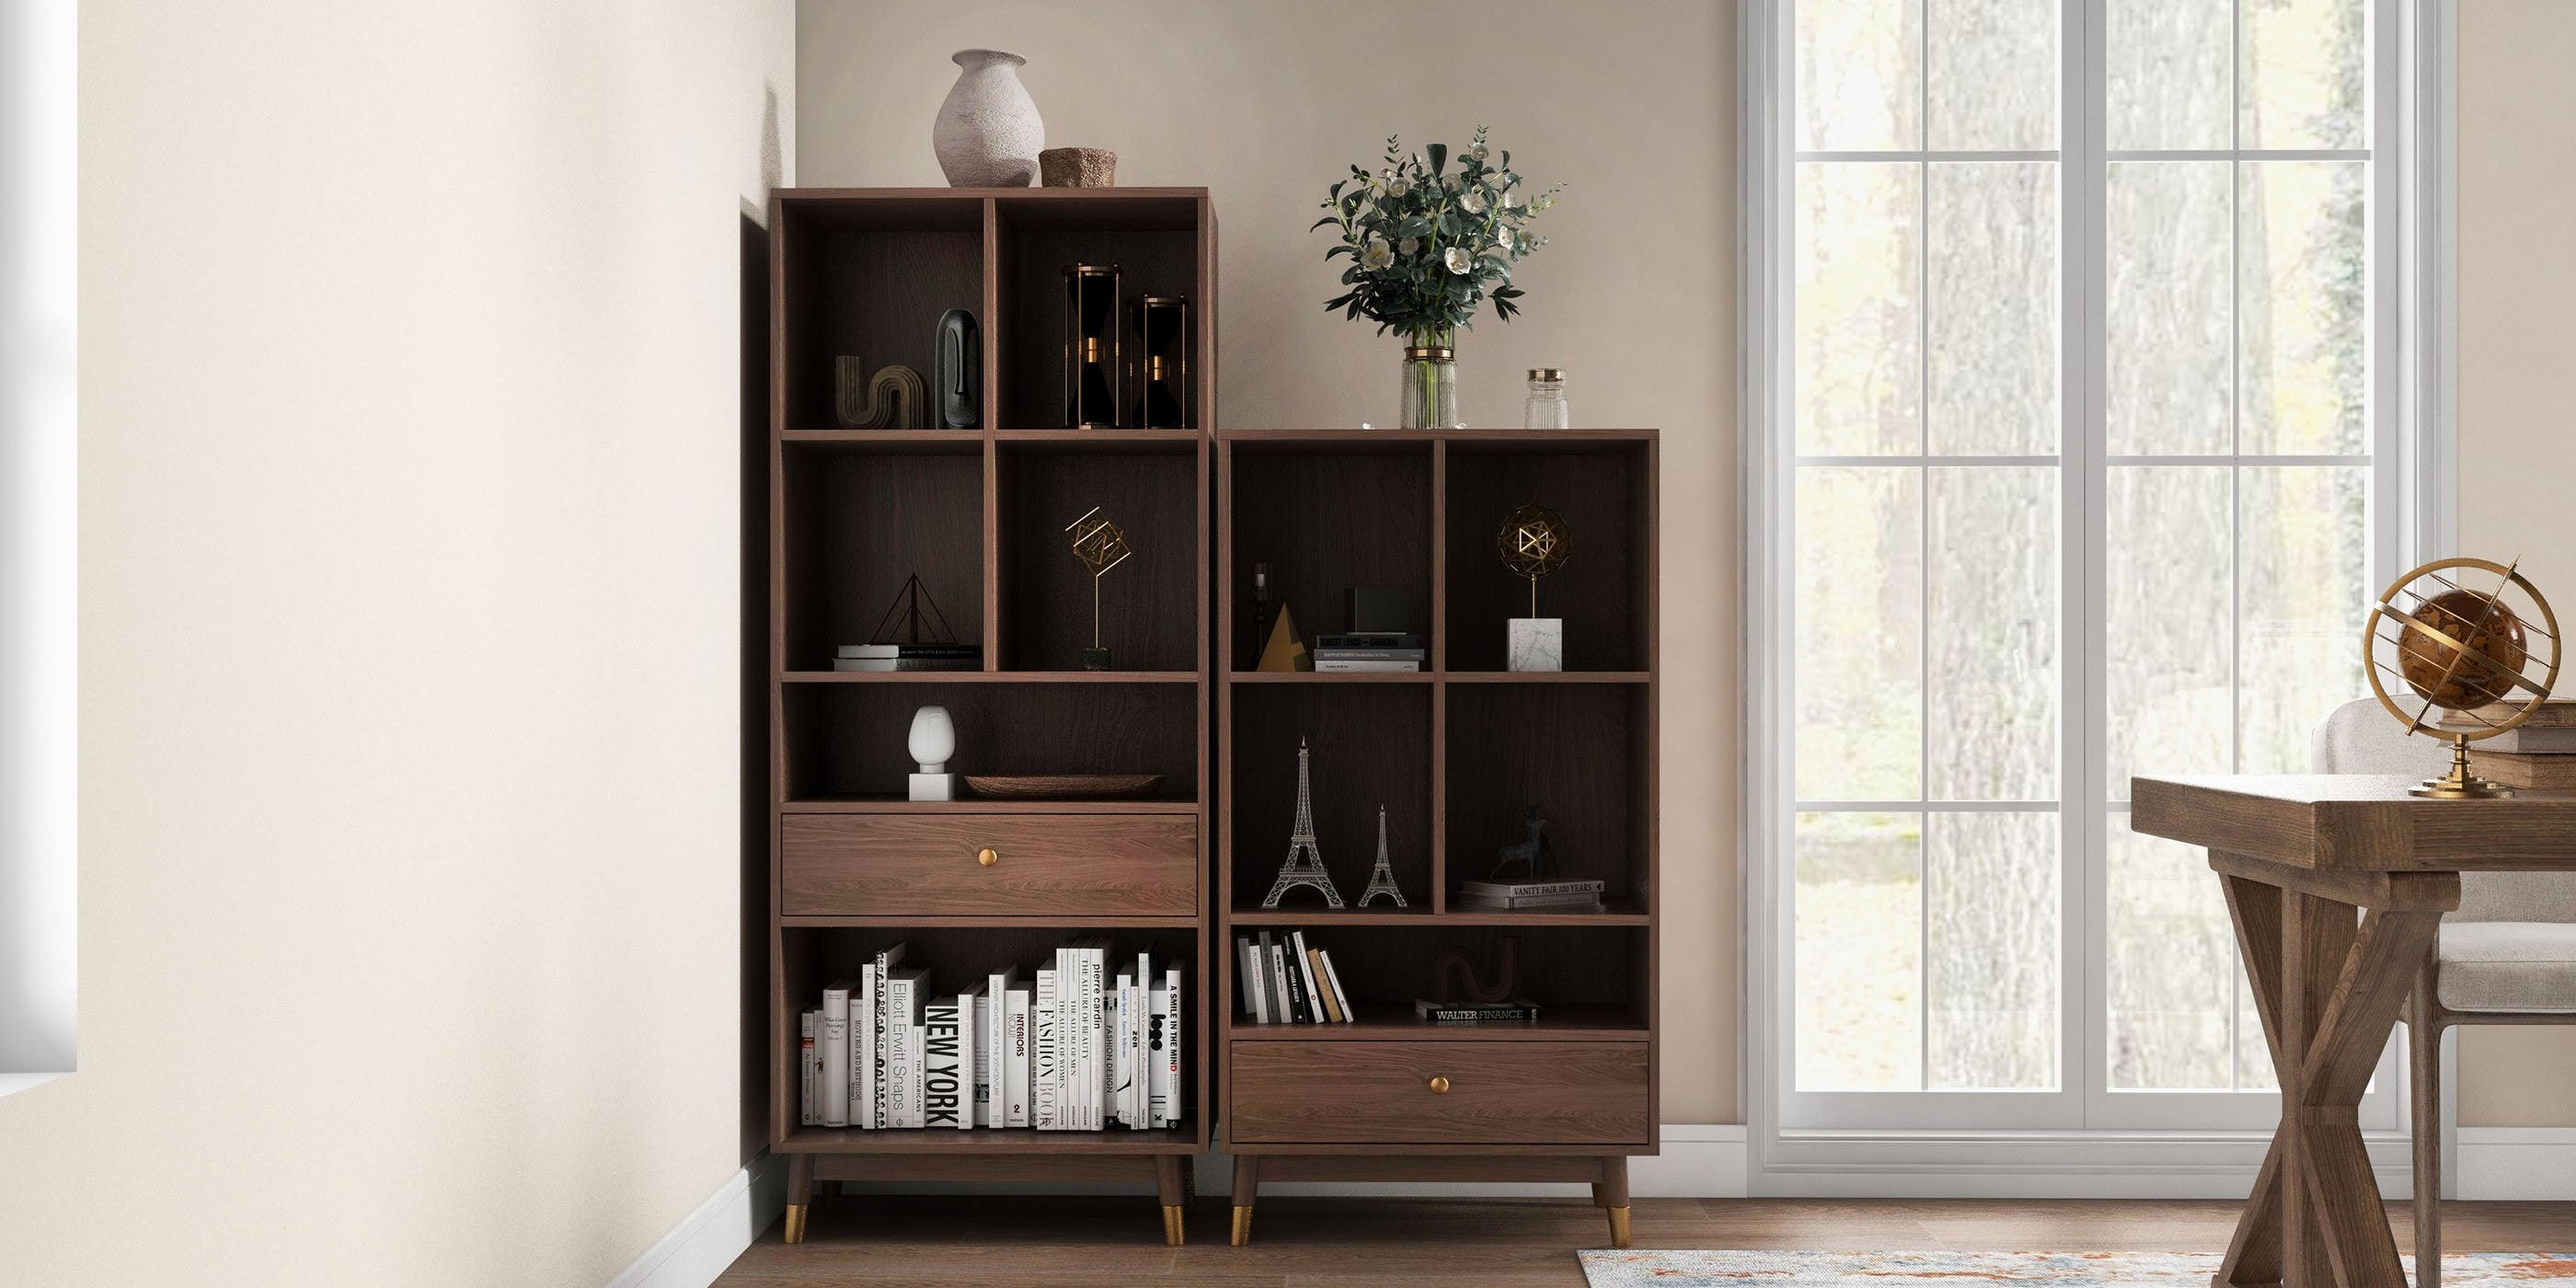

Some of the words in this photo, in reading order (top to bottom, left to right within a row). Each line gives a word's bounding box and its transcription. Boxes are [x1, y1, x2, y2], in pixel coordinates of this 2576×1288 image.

[1513, 887, 1540, 895] VANITY
[1542, 886, 1558, 894] FAIR
[1570, 883, 1592, 891] YEARS
[1040, 972, 1054, 1005] THE
[1092, 964, 1100, 994] pierre
[893, 983, 906, 1018] Elliott
[1436, 1011, 1478, 1019] WALTER
[1478, 1010, 1523, 1018] FINANCE
[926, 1008, 959, 1057] NEW
[1082, 1012, 1088, 1024] OF
[1149, 1014, 1167, 1051] logo
[1170, 1021, 1178, 1029] IN
[893, 1024, 906, 1061] Erwitt
[1040, 1010, 1054, 1077] FASHION
[1060, 1047, 1065, 1058] OF
[1071, 1047, 1076, 1058] OF
[891, 1065, 906, 1110] Snaps
[926, 1064, 959, 1124] YORK
[1014, 1104, 1020, 1113] 2
[1040, 1083, 1054, 1126] BOOK
